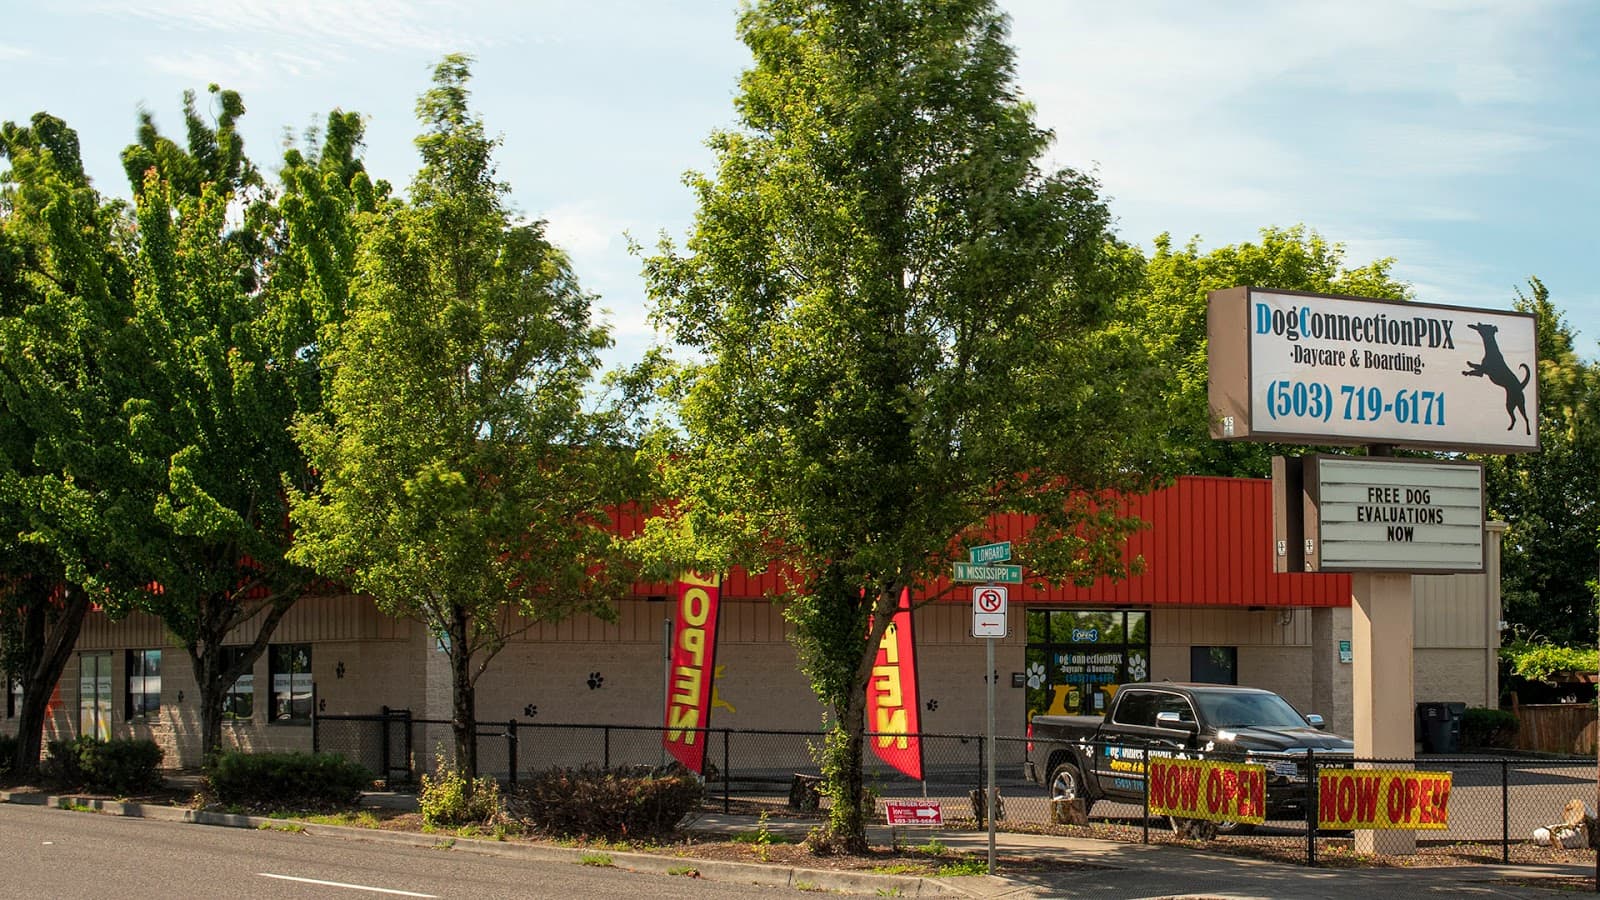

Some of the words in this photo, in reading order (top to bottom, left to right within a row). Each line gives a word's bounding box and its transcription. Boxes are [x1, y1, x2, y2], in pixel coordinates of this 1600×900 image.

[1255, 303, 1455, 350] DogConnectionPDX
[1349, 348, 1360, 368] &
[1267, 380, 1333, 423] (503)
[1341, 385, 1446, 426] 719-6171
[1368, 487, 1400, 504] FREE
[1406, 489, 1431, 505] DOG
[1357, 506, 1444, 525] EVALUATIONS
[1387, 526, 1414, 543] NOW
[977, 545, 1005, 562] LOMBARD
[958, 566, 964, 579] N
[966, 567, 1009, 580] MISSISSIPPI
[1150, 763, 1201, 812] NOW
[1207, 768, 1264, 817] OPEN
[1320, 776, 1381, 823] NOW
[1388, 777, 1450, 824] OPEN
